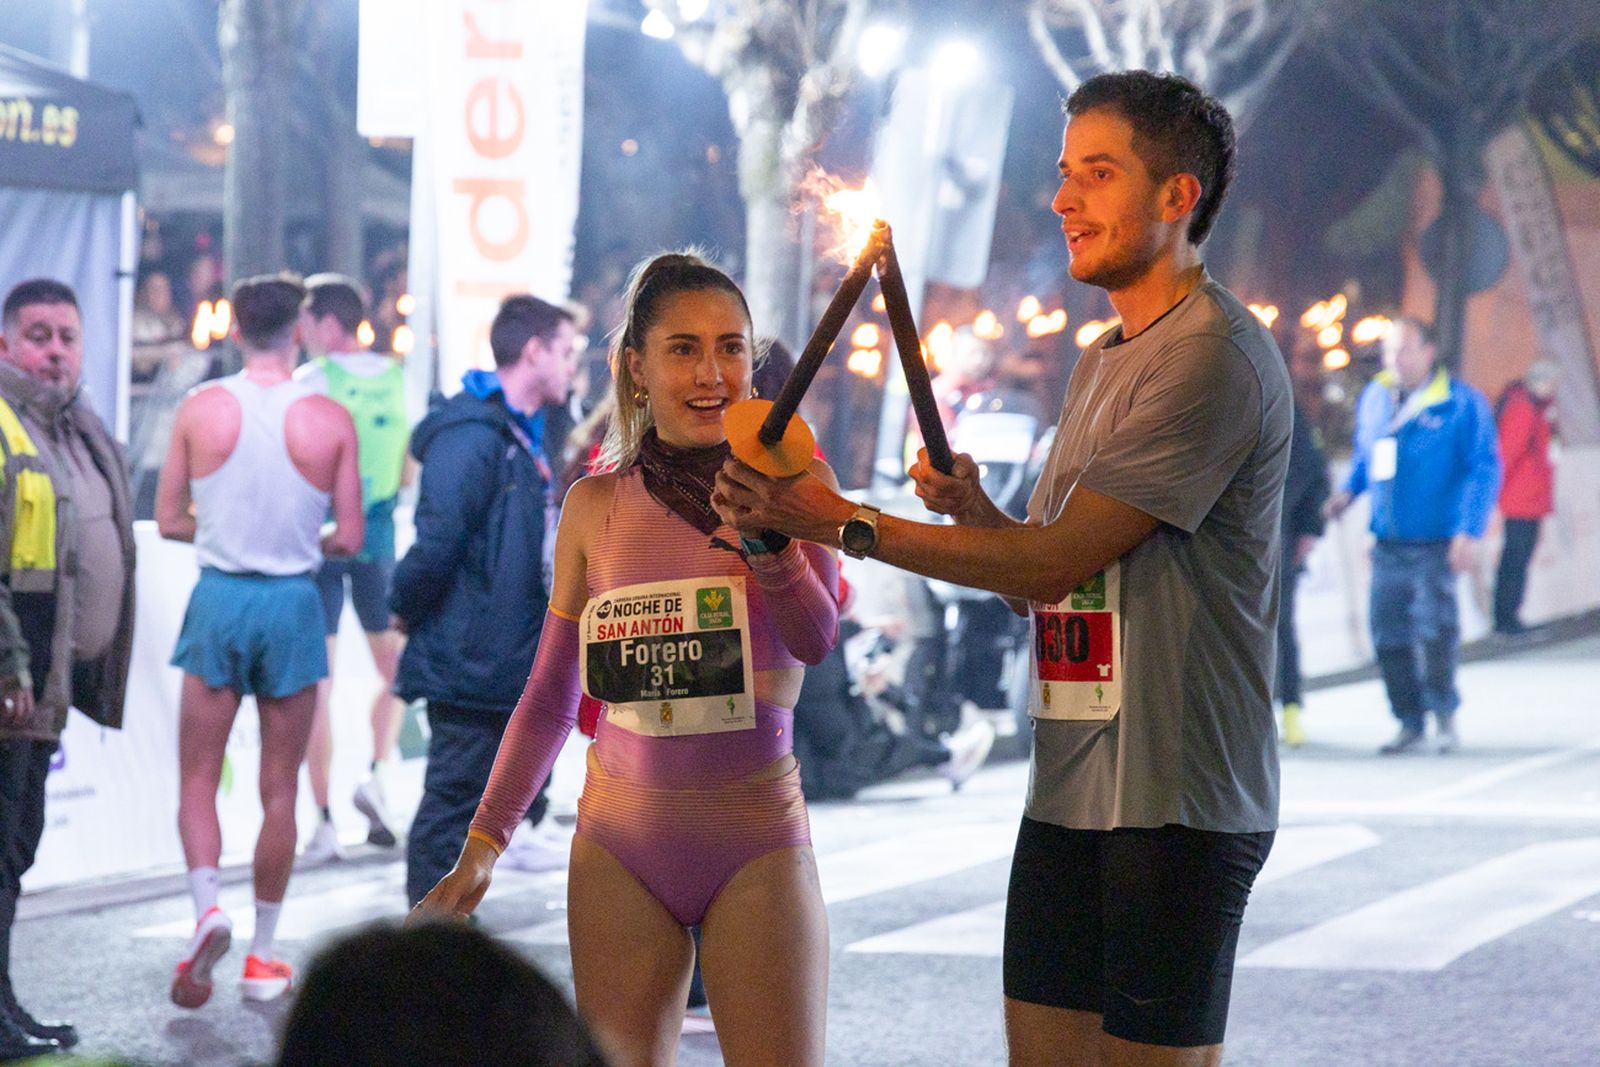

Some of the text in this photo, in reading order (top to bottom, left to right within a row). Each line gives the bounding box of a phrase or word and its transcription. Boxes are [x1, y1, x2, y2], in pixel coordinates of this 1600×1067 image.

[613, 598, 682, 618] NOCHE DE
[597, 622, 627, 641] SAN
[630, 614, 684, 637] ANTÓN
[620, 639, 703, 667] Forero
[650, 664, 675, 687] 31
[666, 687, 689, 696] Forero
